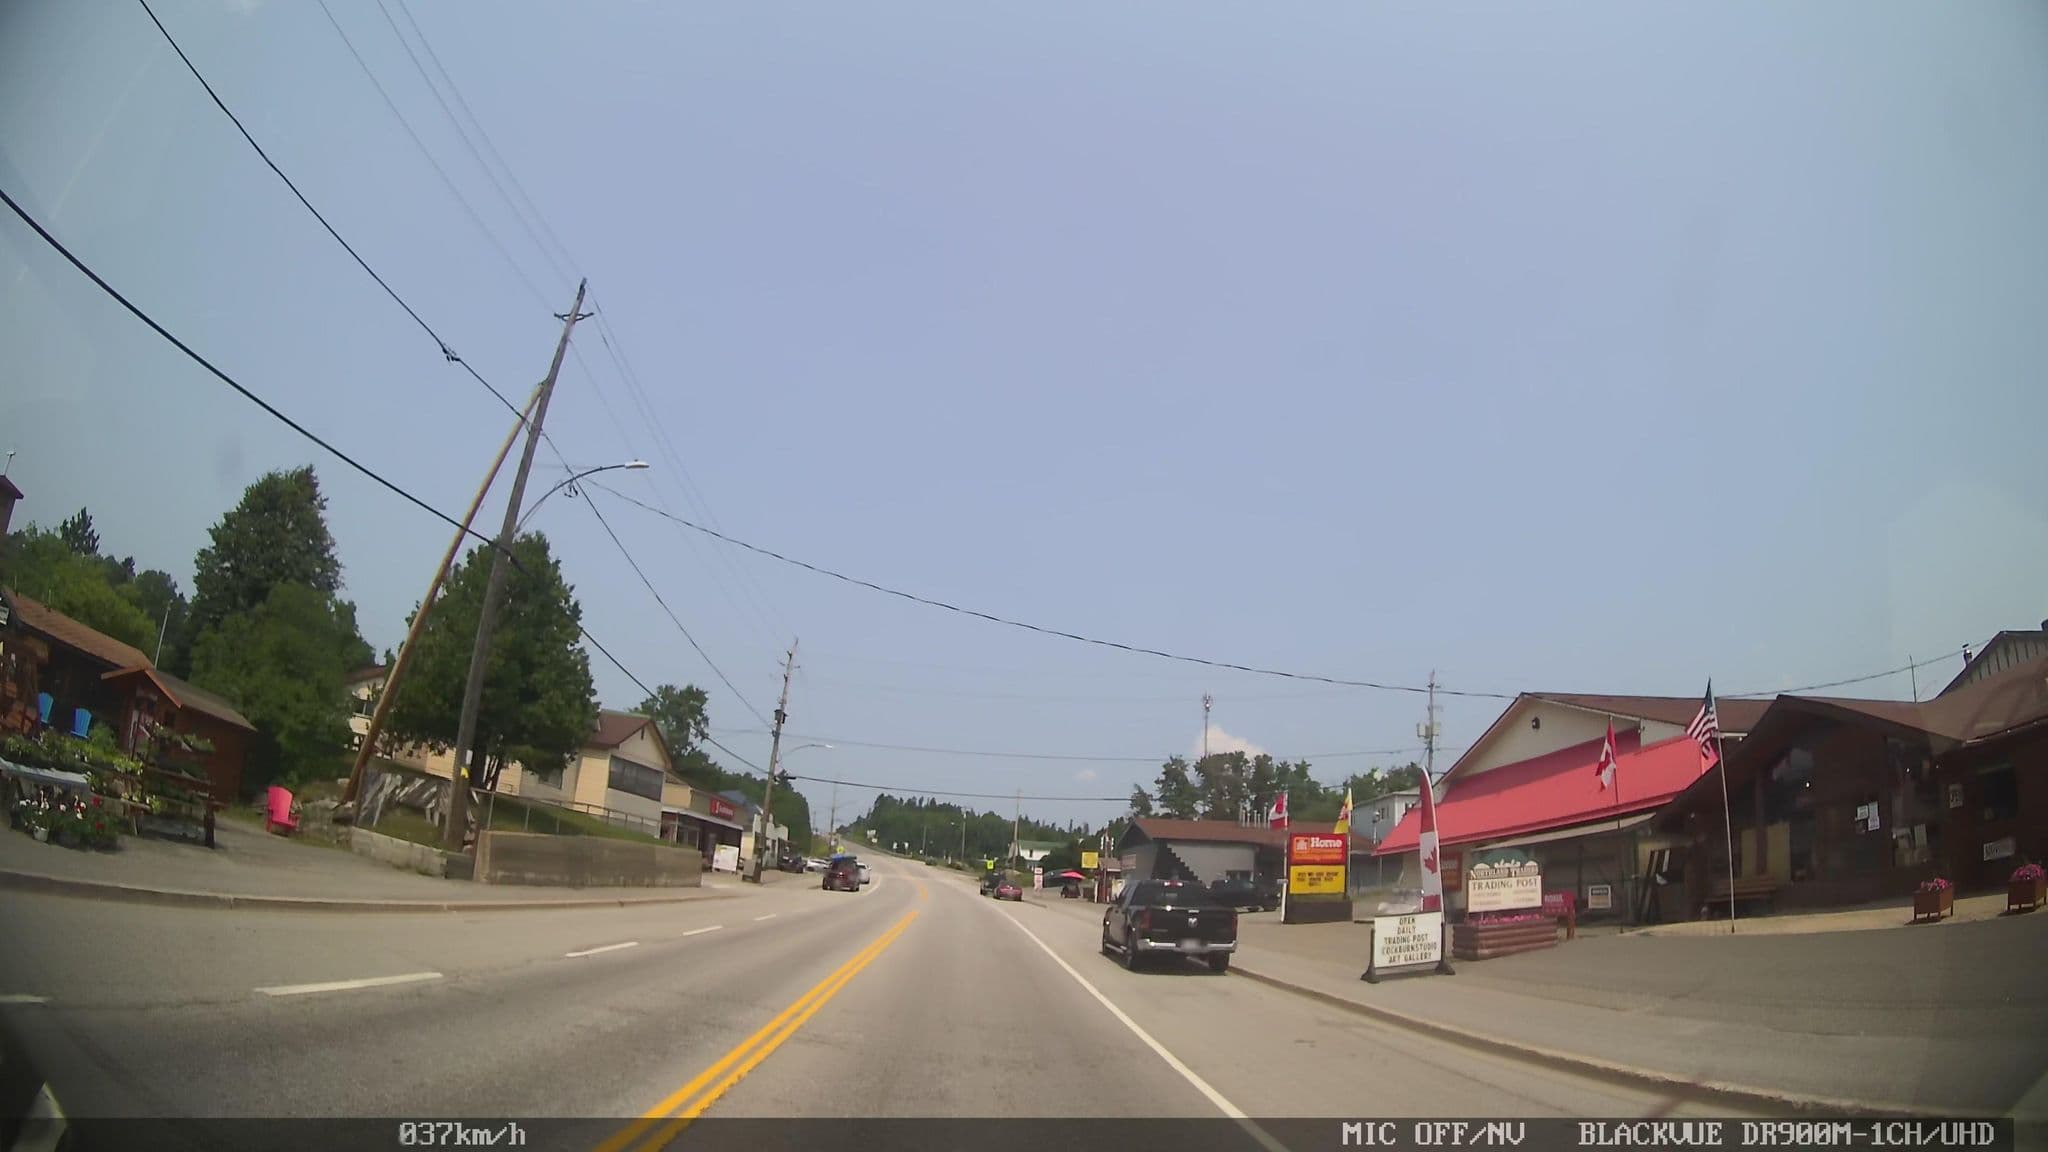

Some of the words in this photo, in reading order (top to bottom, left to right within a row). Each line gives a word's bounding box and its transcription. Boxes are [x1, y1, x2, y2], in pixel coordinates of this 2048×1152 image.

[1311, 837, 1342, 847] Home
[1472, 880, 1513, 891] TRADING
[1516, 879, 1538, 888] POST
[1400, 917, 1415, 925] OPEN
[1397, 926, 1416, 934] DAILY
[1384, 936, 1410, 944] TRADING
[1412, 934, 1428, 942] POST
[1389, 955, 1401, 963] ART
[1404, 953, 1432, 961] GALLERY
